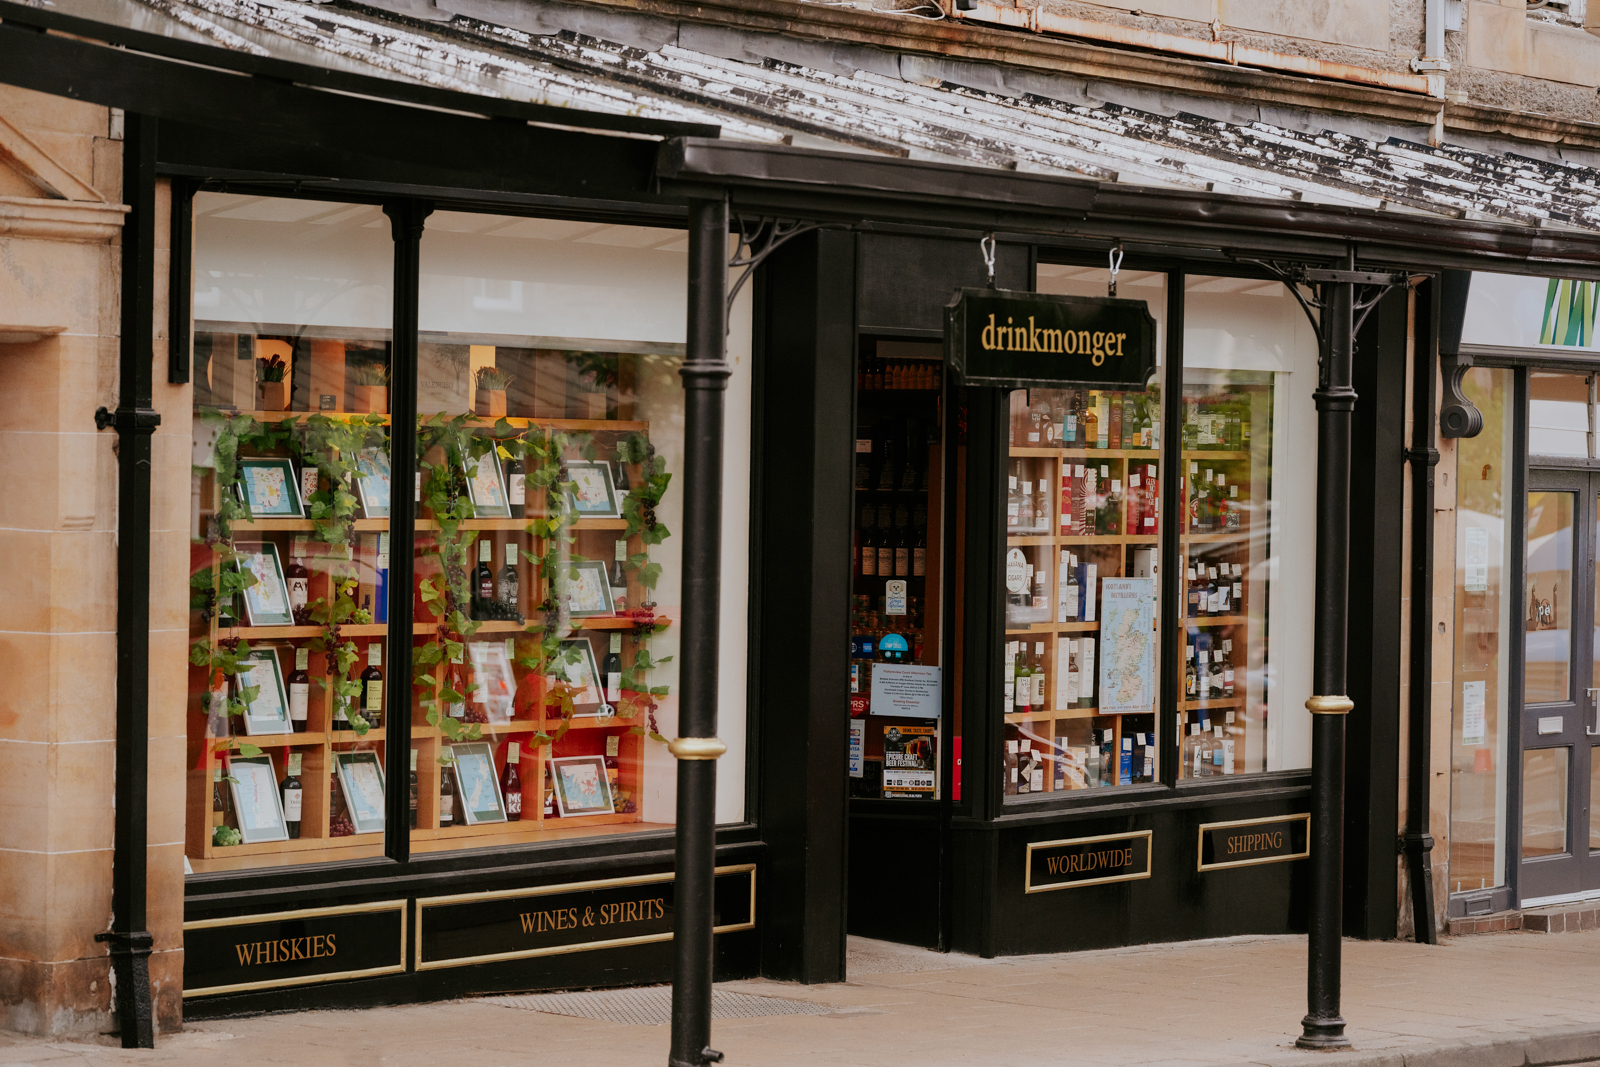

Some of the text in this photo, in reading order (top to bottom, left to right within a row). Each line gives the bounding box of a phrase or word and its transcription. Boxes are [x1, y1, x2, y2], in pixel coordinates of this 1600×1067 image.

[981, 313, 1127, 367] drinkmonger
[1227, 831, 1283, 854] SHIPPING
[1046, 848, 1133, 875] WORLDWIDE
[519, 897, 664, 934] WINES & SPIRITS
[235, 933, 337, 967] WHISKIES
